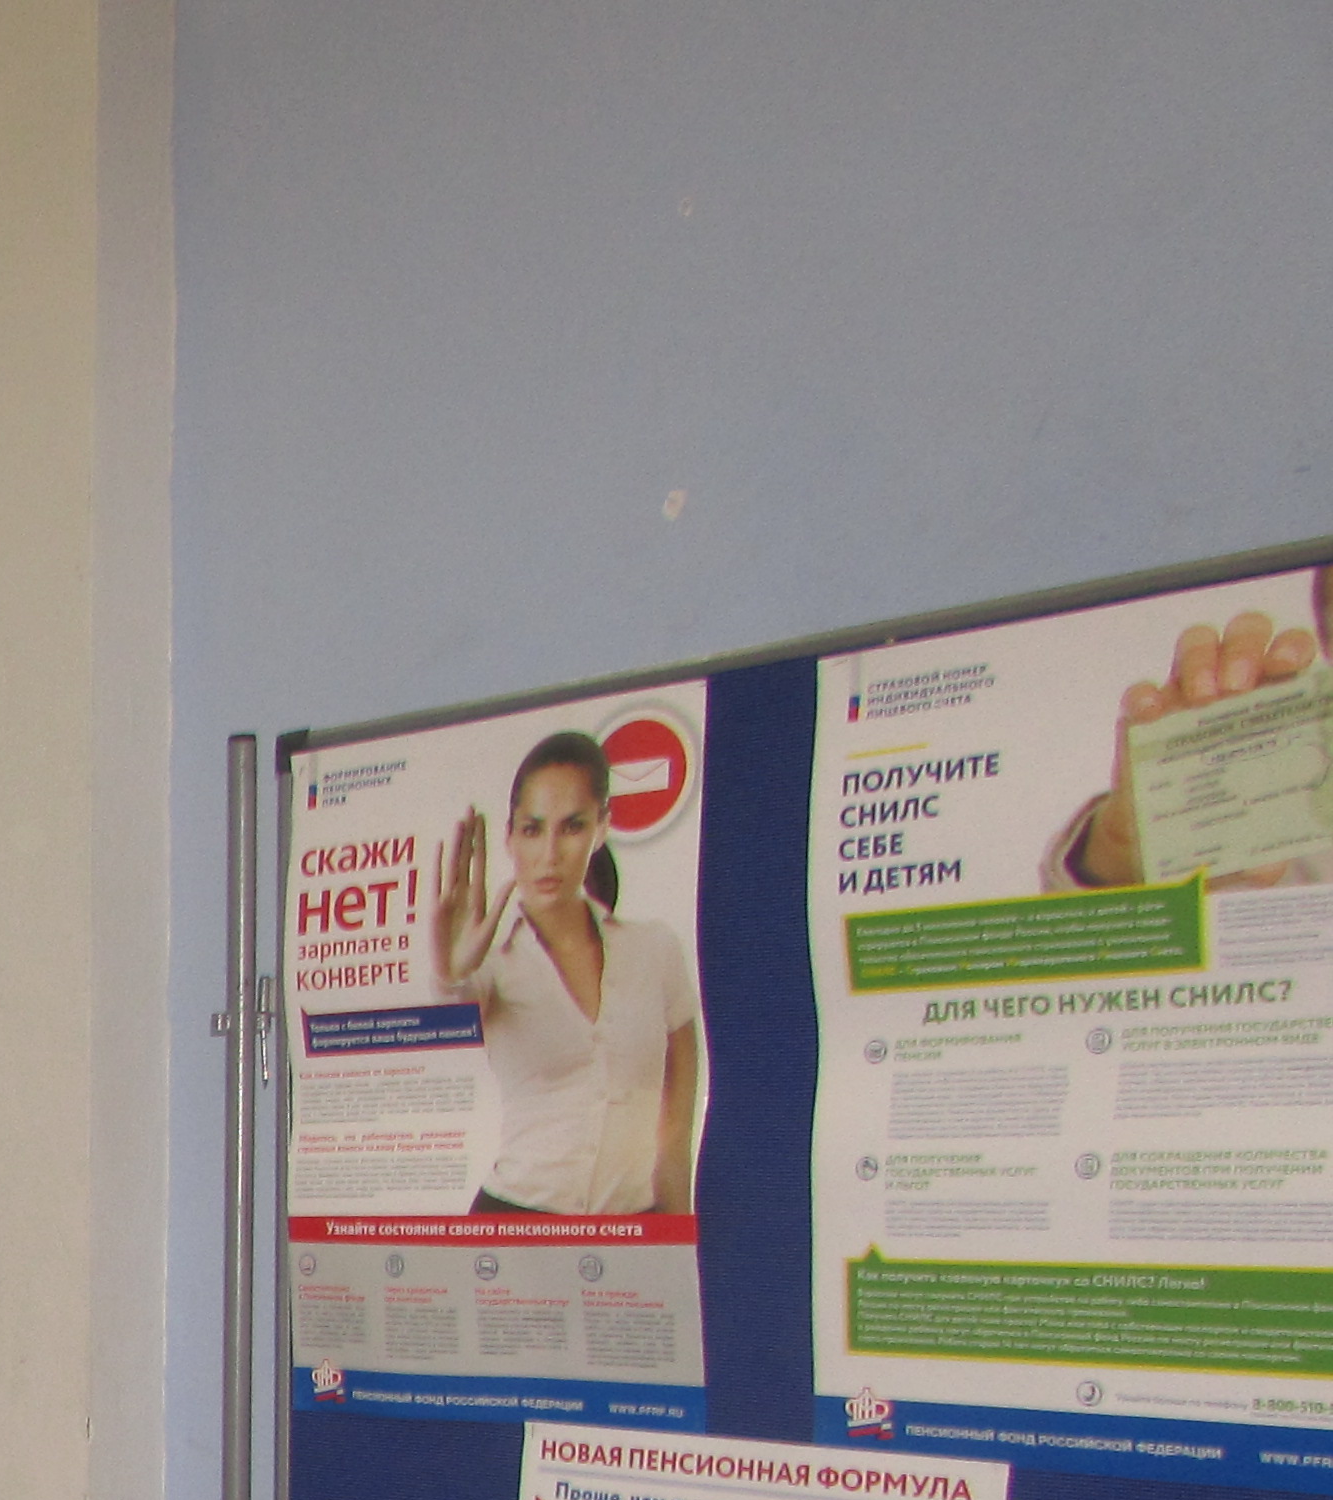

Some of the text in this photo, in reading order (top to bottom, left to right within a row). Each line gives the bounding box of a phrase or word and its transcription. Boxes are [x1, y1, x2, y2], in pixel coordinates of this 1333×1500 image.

[843, 754, 999, 796] ПОЛУЧИТЕ
[839, 795, 939, 828] СНИЛС
[300, 836, 415, 877] скажи
[839, 832, 903, 861] СЕБЕ
[839, 860, 961, 895] И ДЕТЯМ
[298, 869, 418, 936] нет!
[297, 934, 409, 963] зарплате в
[296, 961, 409, 992] КОНВЕРТЕ
[923, 980, 1292, 1024] ДЛЯ ЧЕГО НУЖЕН СНИЛС?
[326, 1221, 643, 1237] Узнайте состояние своего пенсионного счета
[905, 1424, 995, 1441] ПЕНСИОННЫЙ
[998, 1431, 1035, 1447] ФОНД
[1038, 1432, 1132, 1452] РОССИЙСКОЙ
[1135, 1441, 1223, 1460] ФЕДЕРАЦИИ
[541, 1440, 623, 1468] НОВАЯ
[628, 1447, 810, 1487] ПЕНСИОННАЯ
